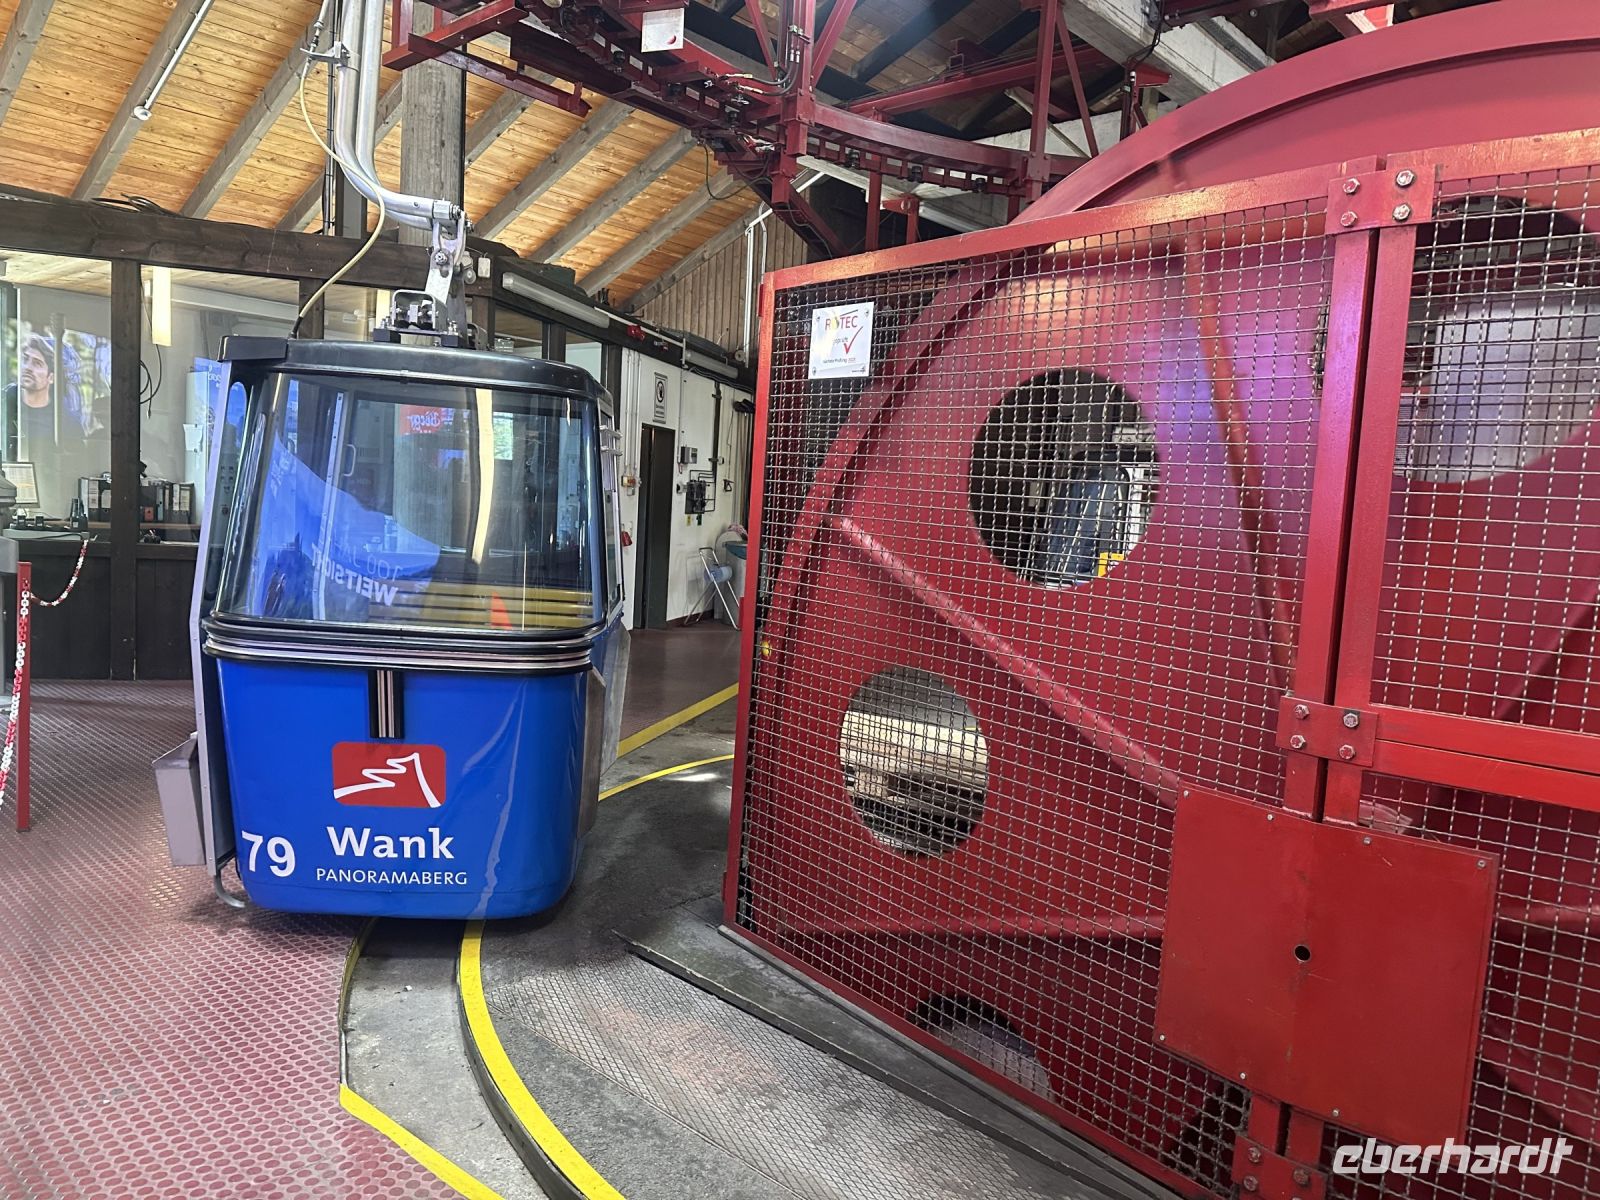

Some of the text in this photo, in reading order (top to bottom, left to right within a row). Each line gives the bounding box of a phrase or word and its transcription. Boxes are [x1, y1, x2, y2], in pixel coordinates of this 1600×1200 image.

[241, 830, 296, 878] 79
[326, 826, 455, 860] Wank
[316, 867, 468, 886] PANORAMABERG
